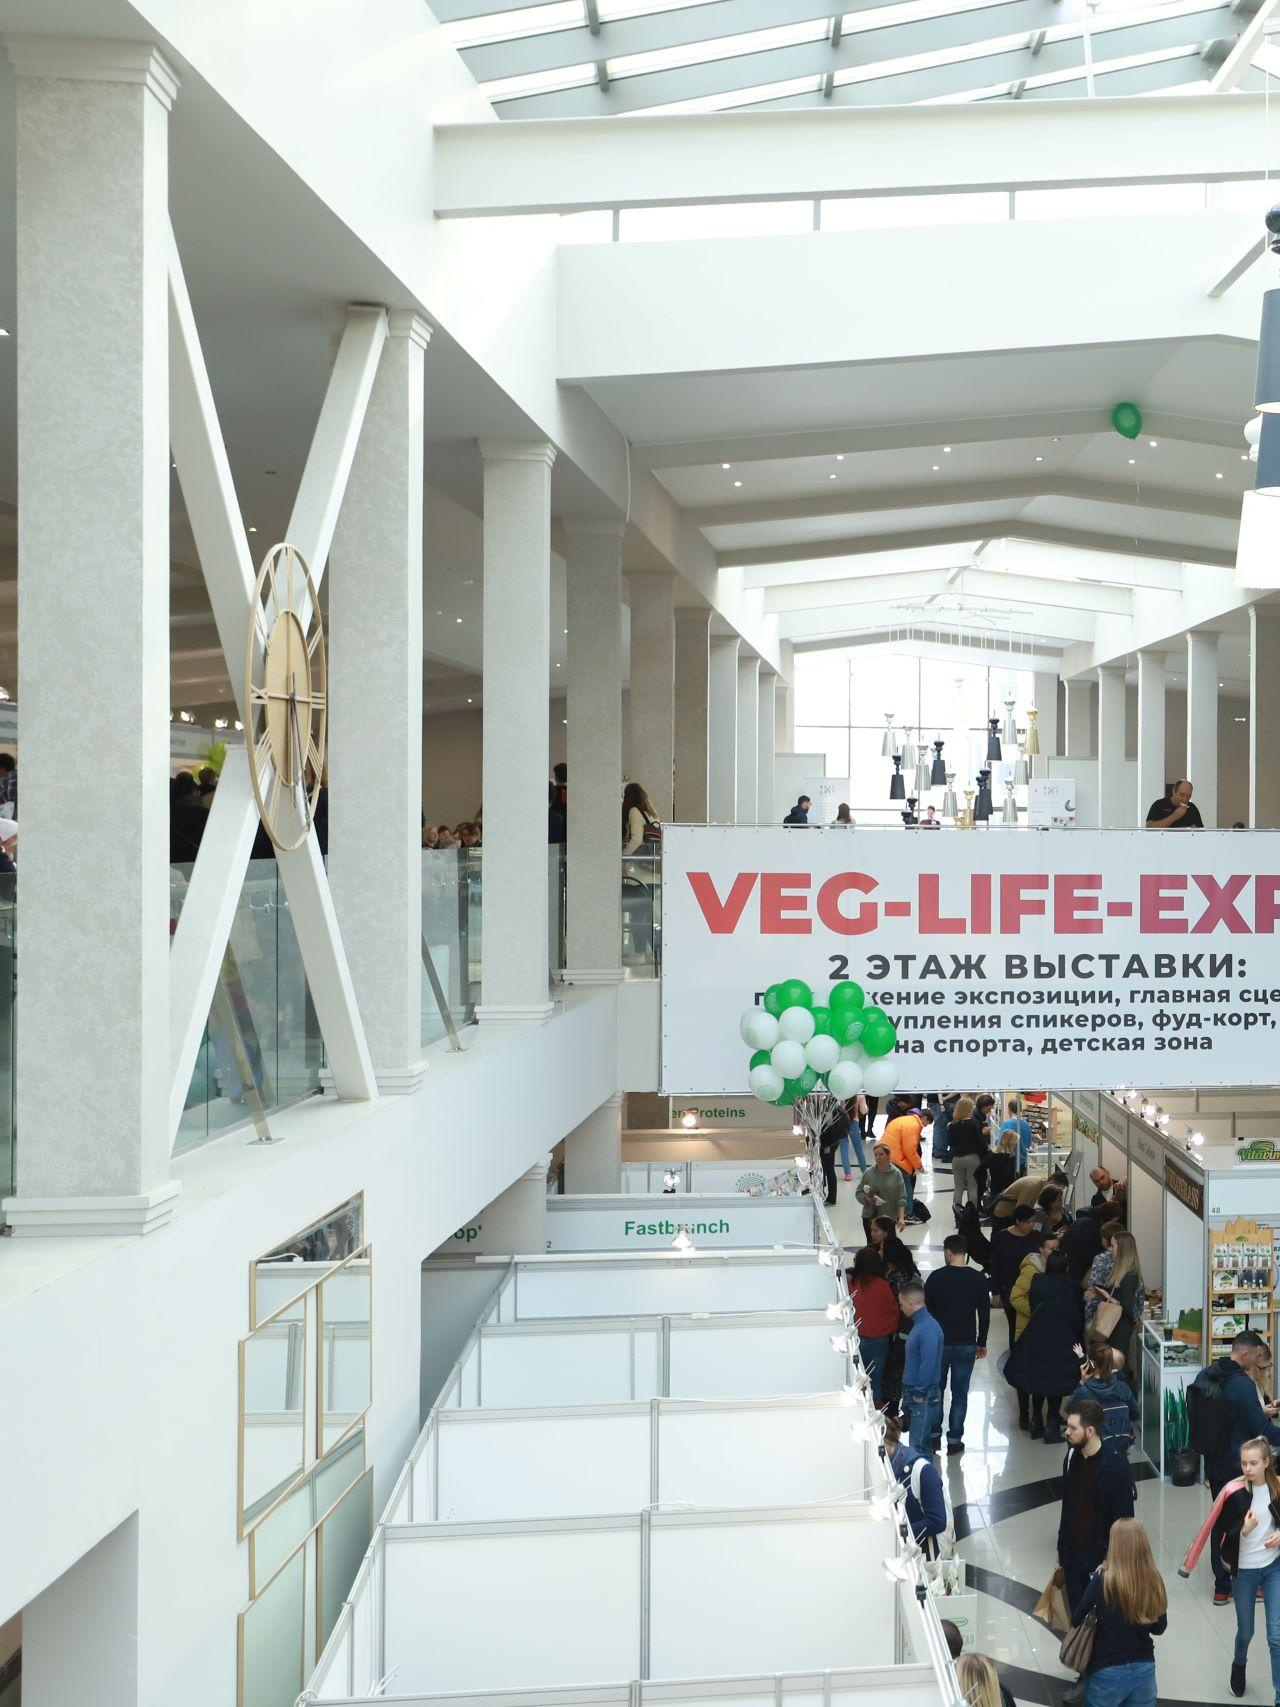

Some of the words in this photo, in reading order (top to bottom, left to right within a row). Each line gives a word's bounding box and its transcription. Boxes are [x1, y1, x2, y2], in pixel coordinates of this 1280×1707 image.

[828, 954, 849, 980] 2
[866, 954, 987, 980] ЭТАЖ
[1005, 953, 1247, 979] ВЫСТАВКИ:
[954, 990, 1121, 1007] экспозиции,
[1130, 989, 1230, 1003] главная
[887, 1014, 1001, 1030] упления
[1011, 1012, 1143, 1032] спикеров,
[1152, 1009, 1277, 1031] фуд-корт,
[894, 1039, 924, 1054] на
[934, 1037, 1033, 1057] спорта,
[1041, 1036, 1145, 1054] детская
[1154, 1036, 1213, 1051] зона
[449, 1225, 482, 1243] op'
